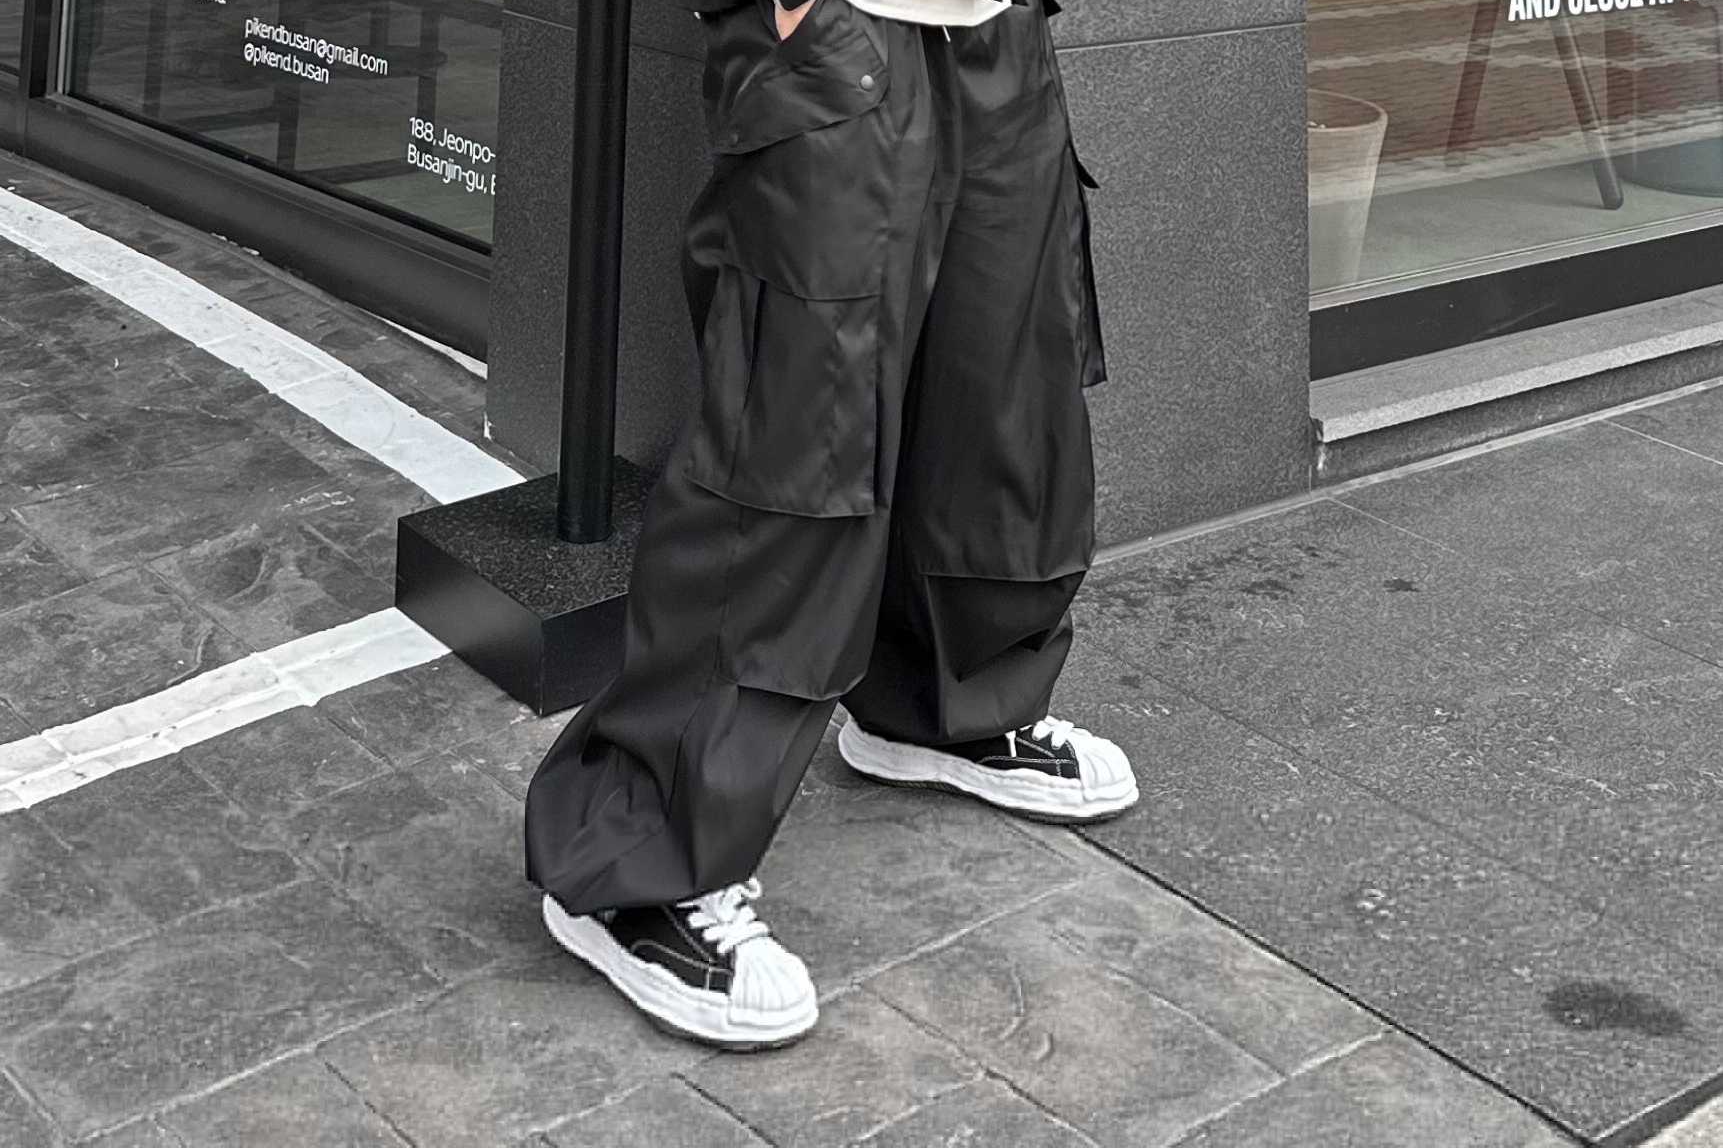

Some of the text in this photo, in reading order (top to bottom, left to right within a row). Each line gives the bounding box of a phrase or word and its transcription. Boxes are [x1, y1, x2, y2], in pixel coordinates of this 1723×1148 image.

[243, 42, 330, 84] @pikend.busan
[244, 17, 388, 76] pikendbusan@gmail.com
[409, 116, 437, 146] 188,
[407, 142, 488, 194] Busanjin-gu,
